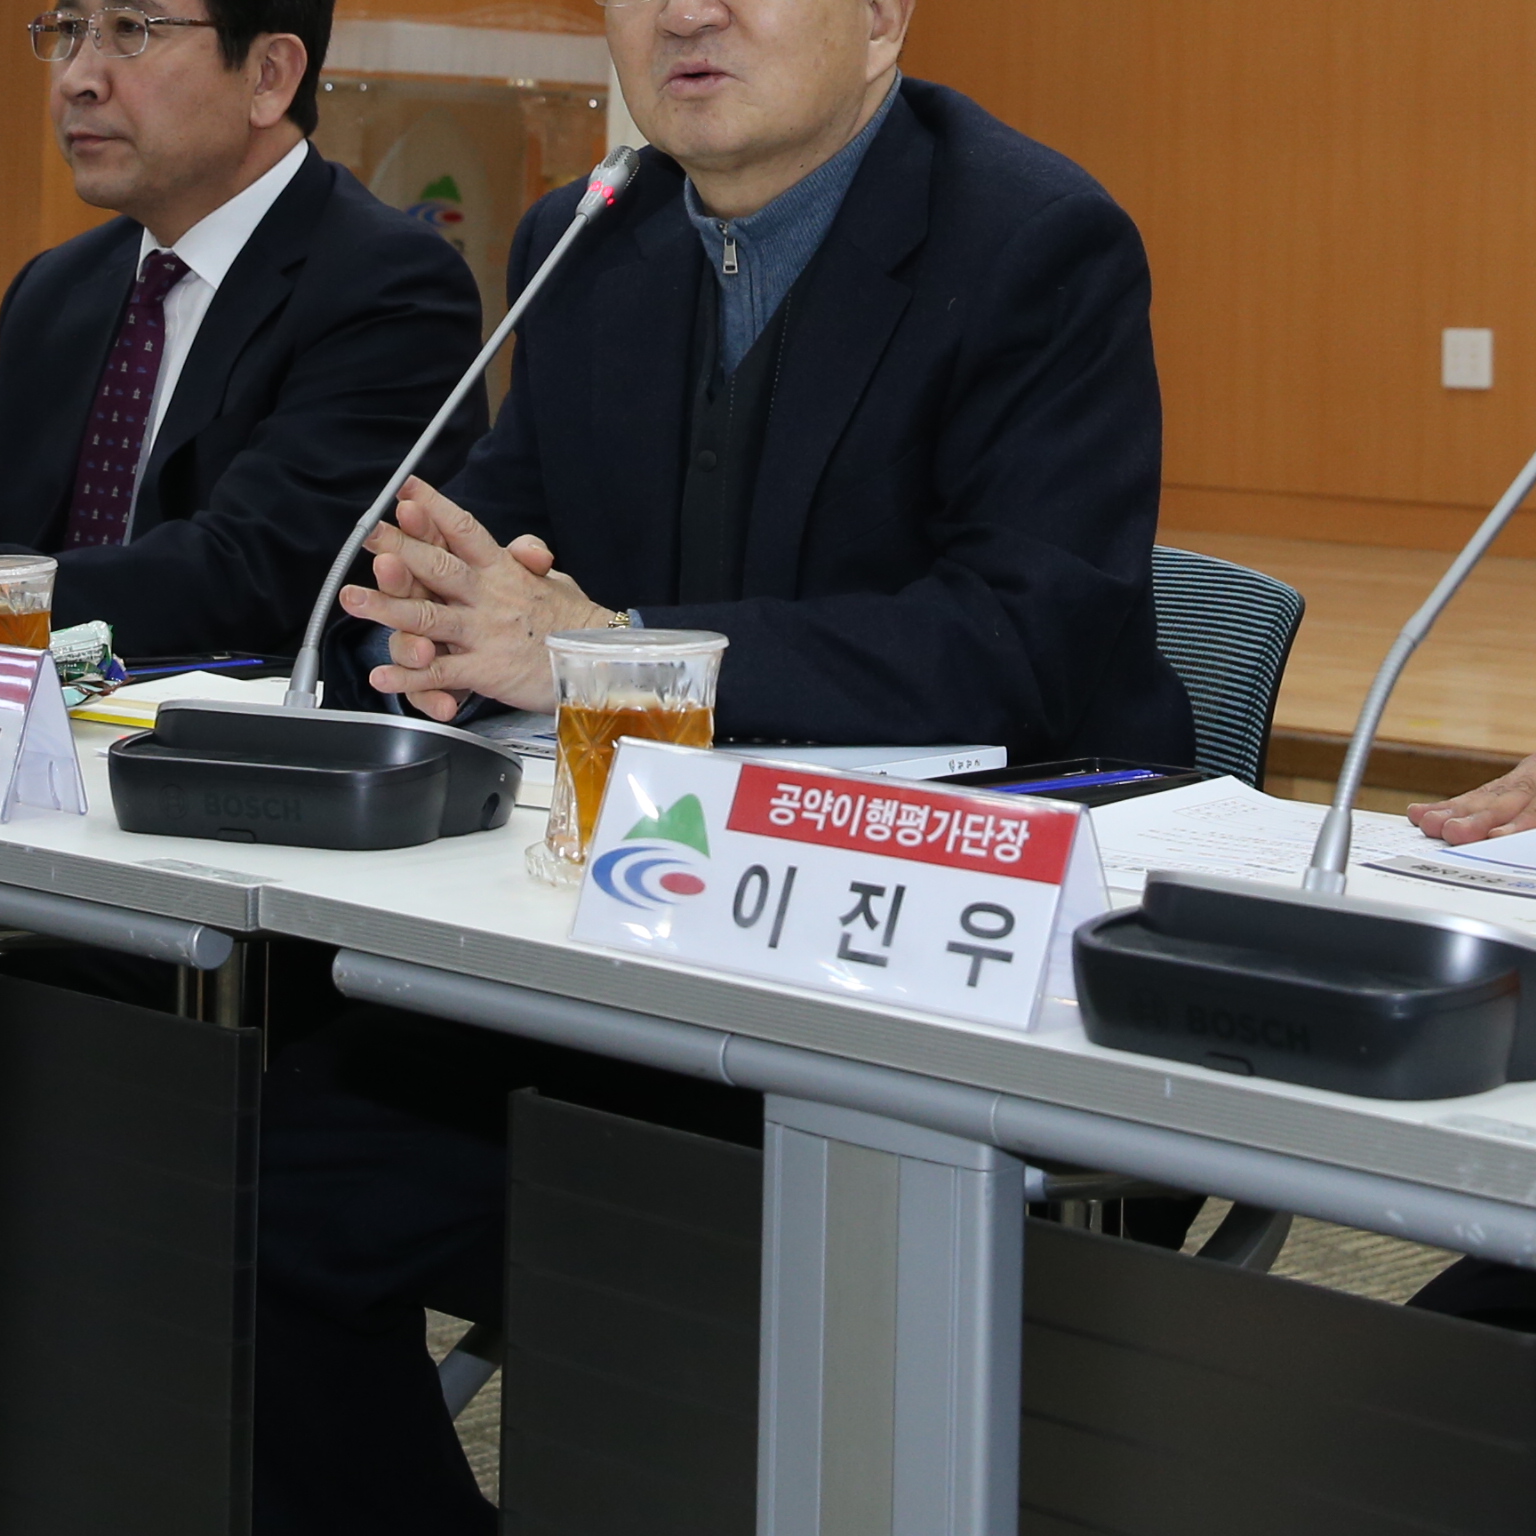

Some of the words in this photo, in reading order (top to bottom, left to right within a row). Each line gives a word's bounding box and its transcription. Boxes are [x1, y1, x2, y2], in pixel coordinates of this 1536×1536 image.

[203, 790, 304, 822] BOSCH
[767, 781, 1031, 865] 공약이행평가단장
[1185, 1002, 1313, 1055] BOSCH
